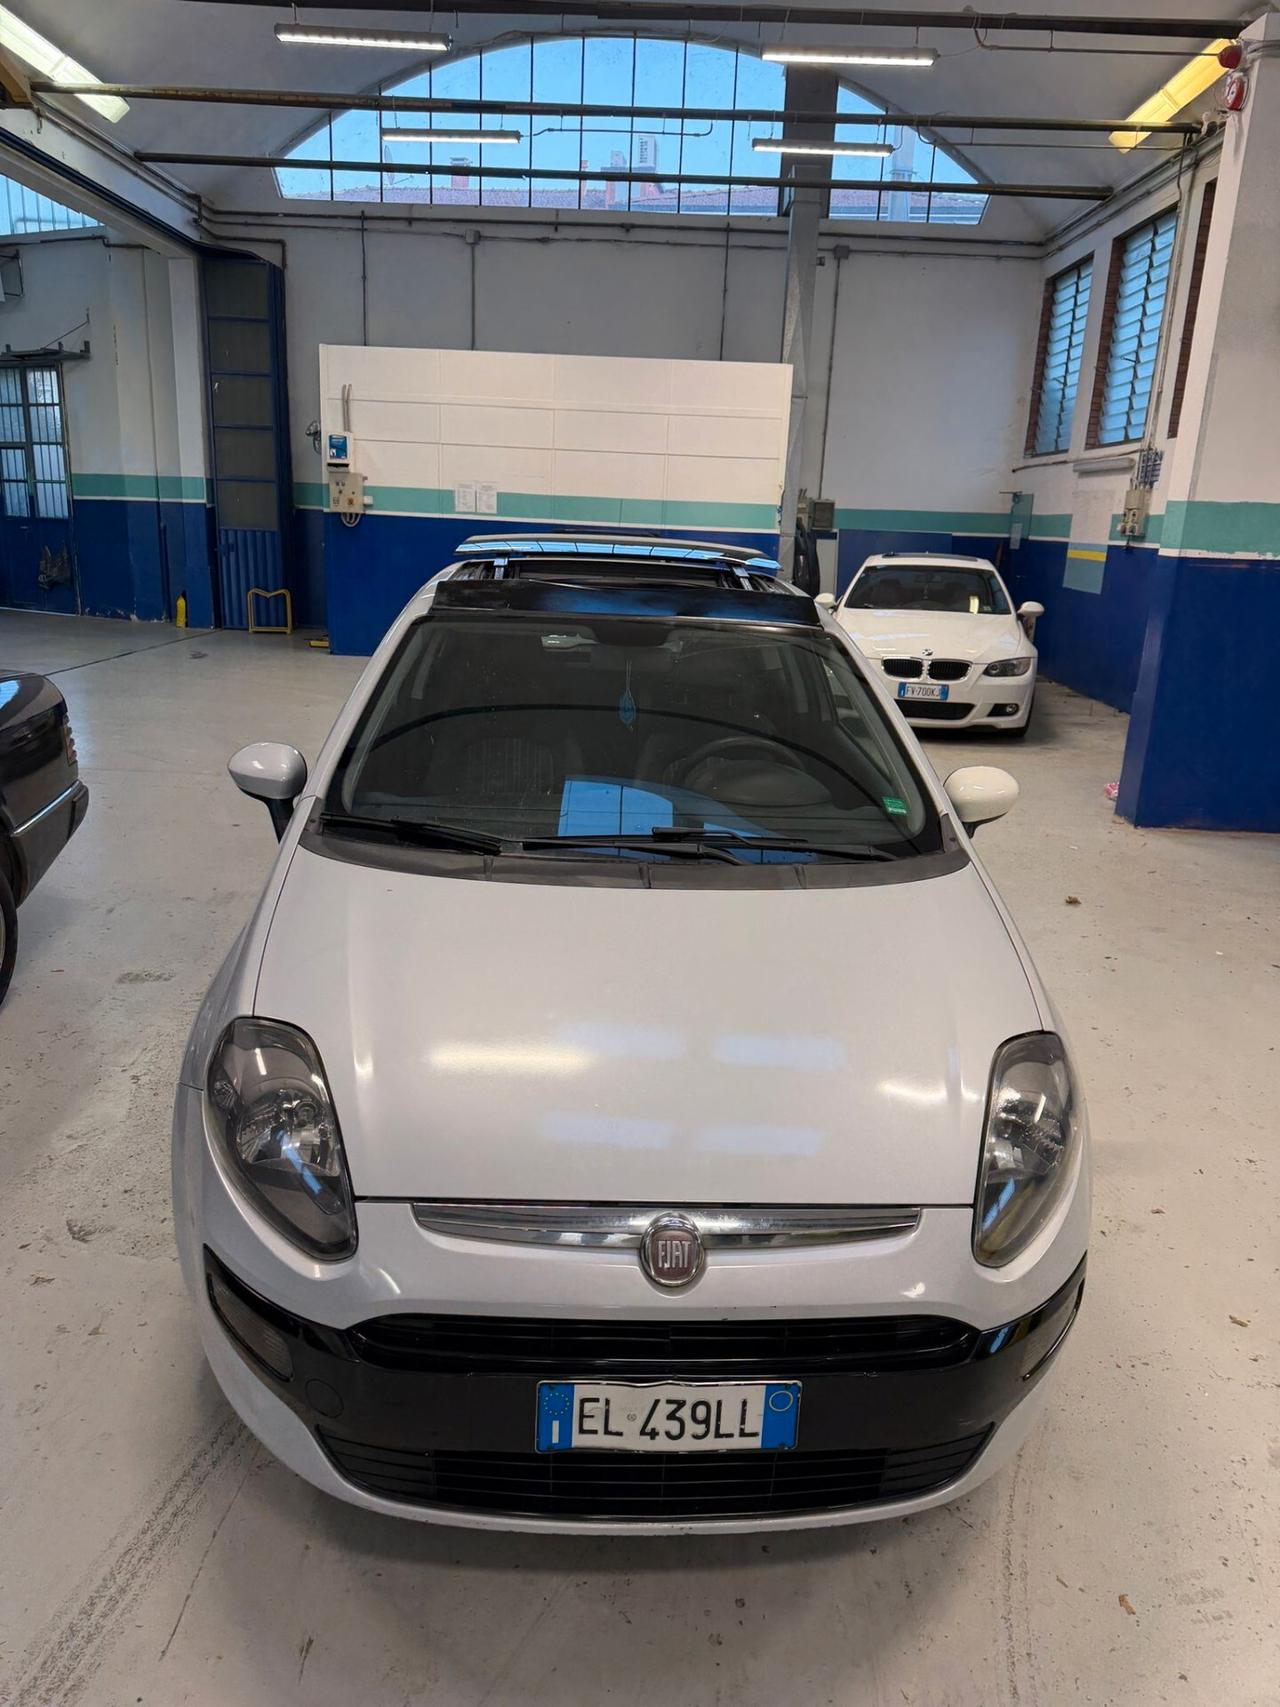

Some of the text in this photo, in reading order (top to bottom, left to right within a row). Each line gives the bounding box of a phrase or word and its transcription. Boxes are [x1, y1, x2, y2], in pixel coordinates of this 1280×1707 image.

[658, 1240, 691, 1268] FIAT
[578, 1397, 760, 1441] EL 439LL
